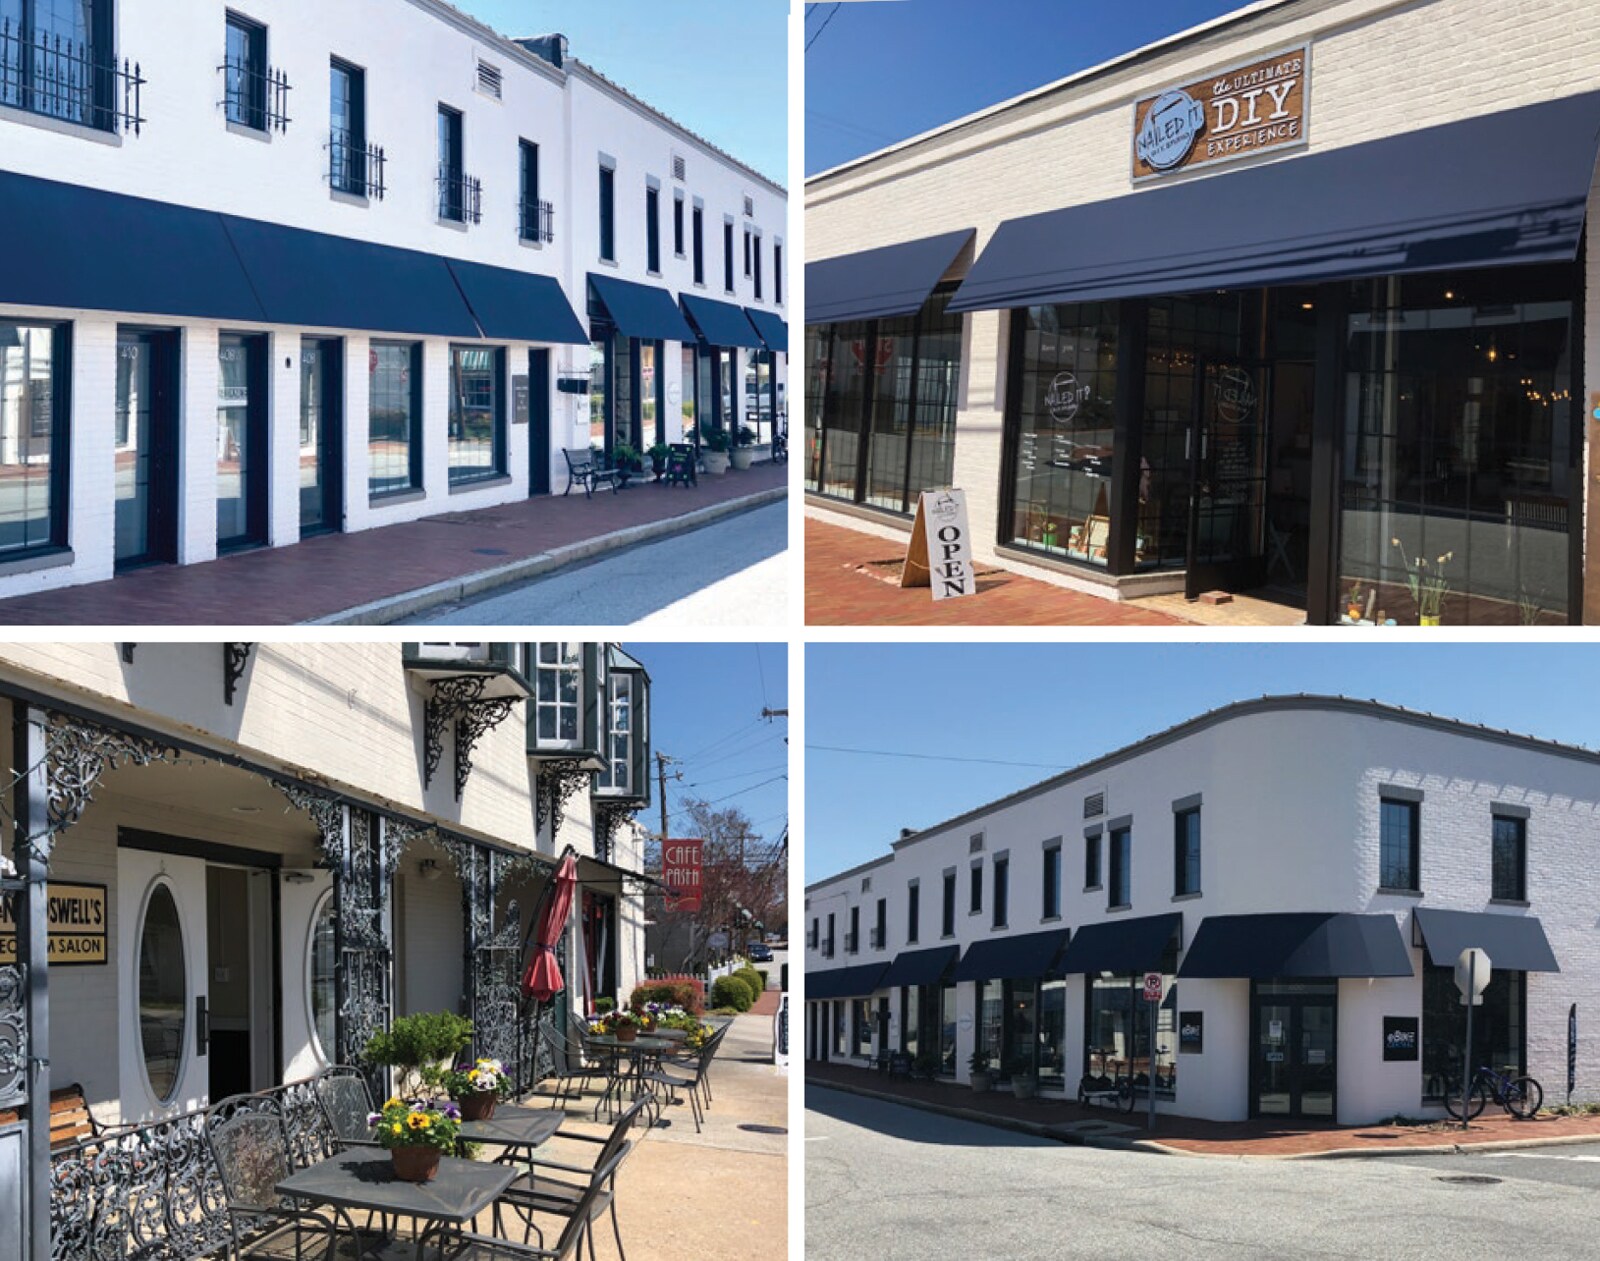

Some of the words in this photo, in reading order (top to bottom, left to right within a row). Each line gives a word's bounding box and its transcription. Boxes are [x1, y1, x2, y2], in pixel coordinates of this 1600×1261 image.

[1234, 58, 1301, 90] ULTIMATE
[1210, 79, 1297, 134] DIY
[1138, 116, 1185, 154] NAILED
[1207, 120, 1298, 157] EXPERIENCE
[121, 345, 138, 360] 410
[938, 525, 965, 598] OPEN
[665, 846, 700, 865] CAFE
[59, 938, 100, 954] SALON
